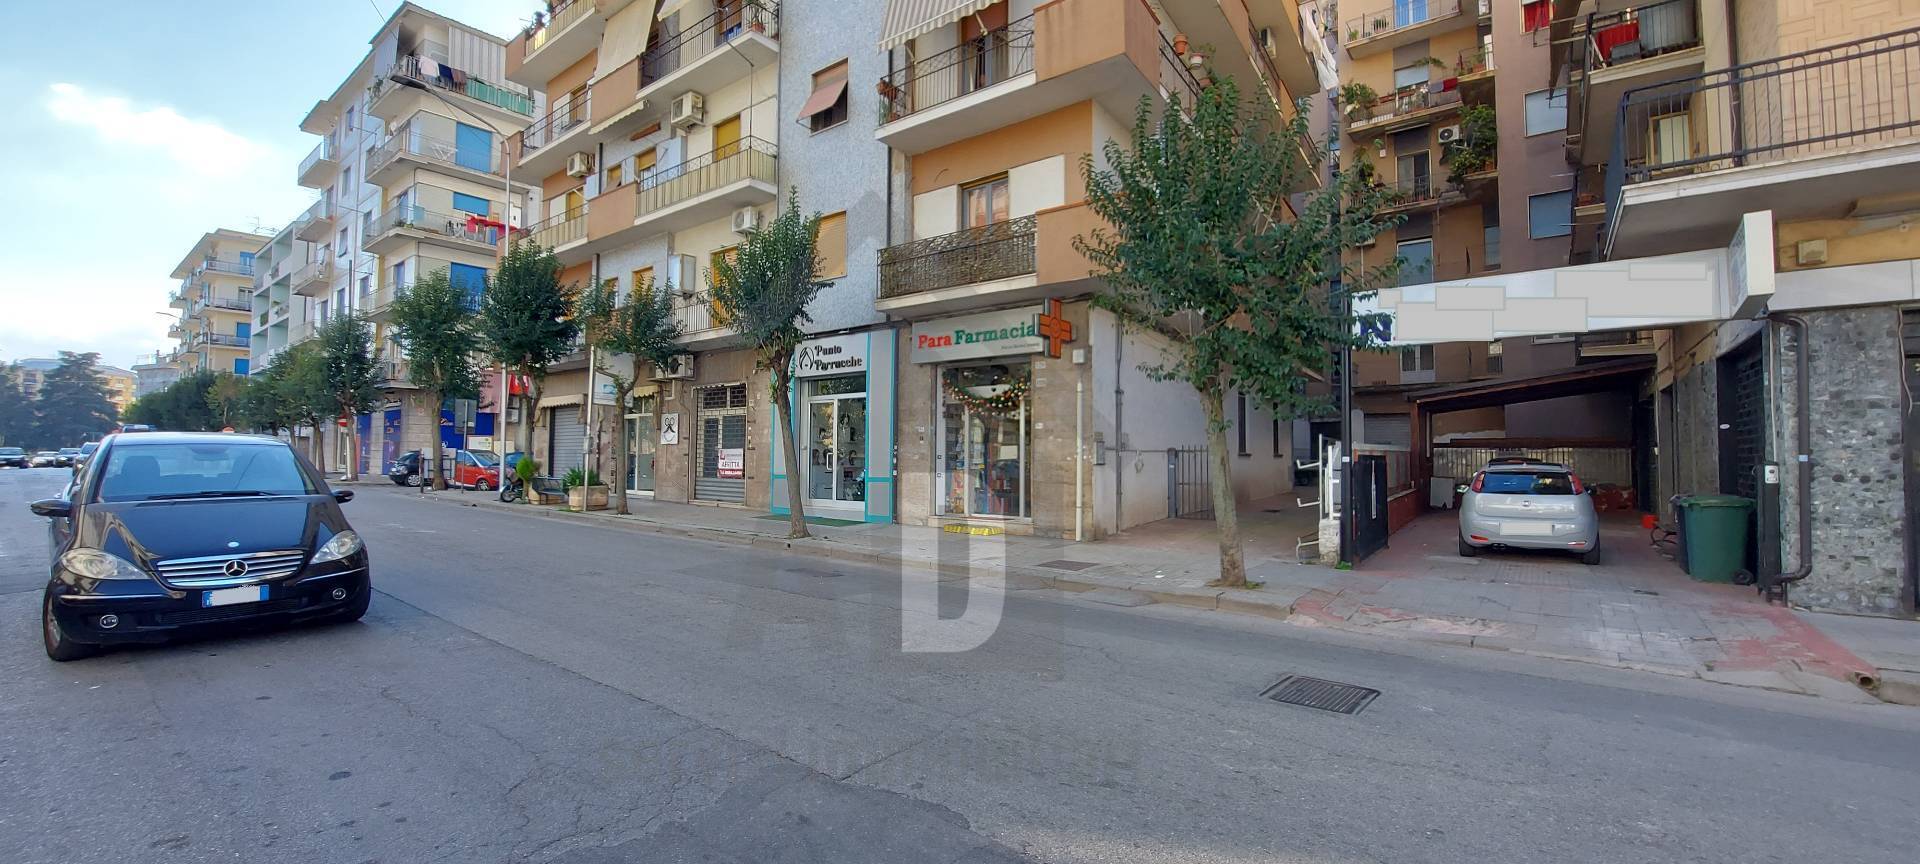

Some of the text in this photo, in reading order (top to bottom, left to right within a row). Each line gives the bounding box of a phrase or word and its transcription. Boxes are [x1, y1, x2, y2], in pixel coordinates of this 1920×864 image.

[918, 322, 1035, 349] Para Farmacia
[814, 356, 863, 371] Parrucche
